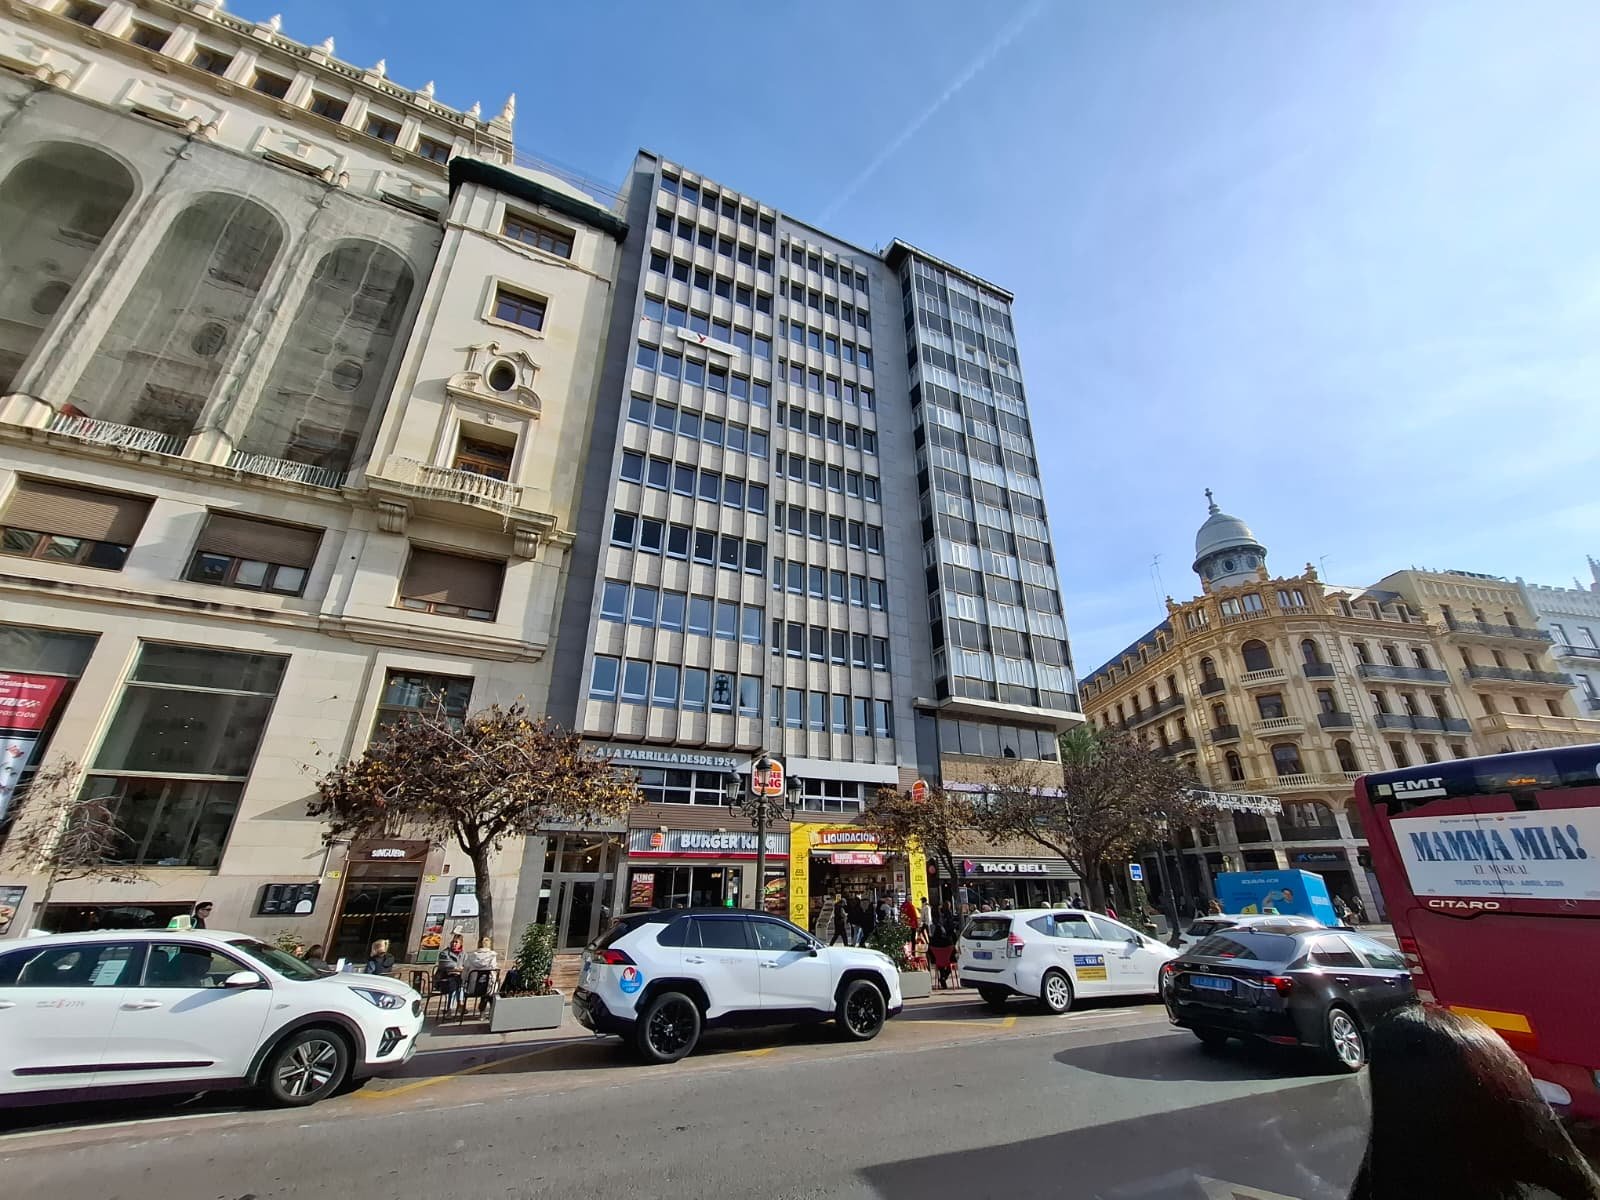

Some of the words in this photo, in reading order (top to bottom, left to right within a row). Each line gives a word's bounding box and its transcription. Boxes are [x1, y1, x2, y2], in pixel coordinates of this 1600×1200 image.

[596, 747, 604, 757] A
[623, 749, 679, 763] PARRILLA
[680, 753, 712, 766] DESDE
[714, 757, 737, 767] 1954
[754, 778, 782, 788] KNG
[1392, 777, 1443, 792] EMT
[680, 834, 737, 849] BURGER
[741, 835, 776, 850] KIG
[1409, 829, 1514, 862] MAMMA
[1509, 824, 1588, 861] MIA!
[981, 863, 1015, 873] TACO
[1018, 863, 1050, 873] BELL
[1428, 899, 1501, 910] CITARO
